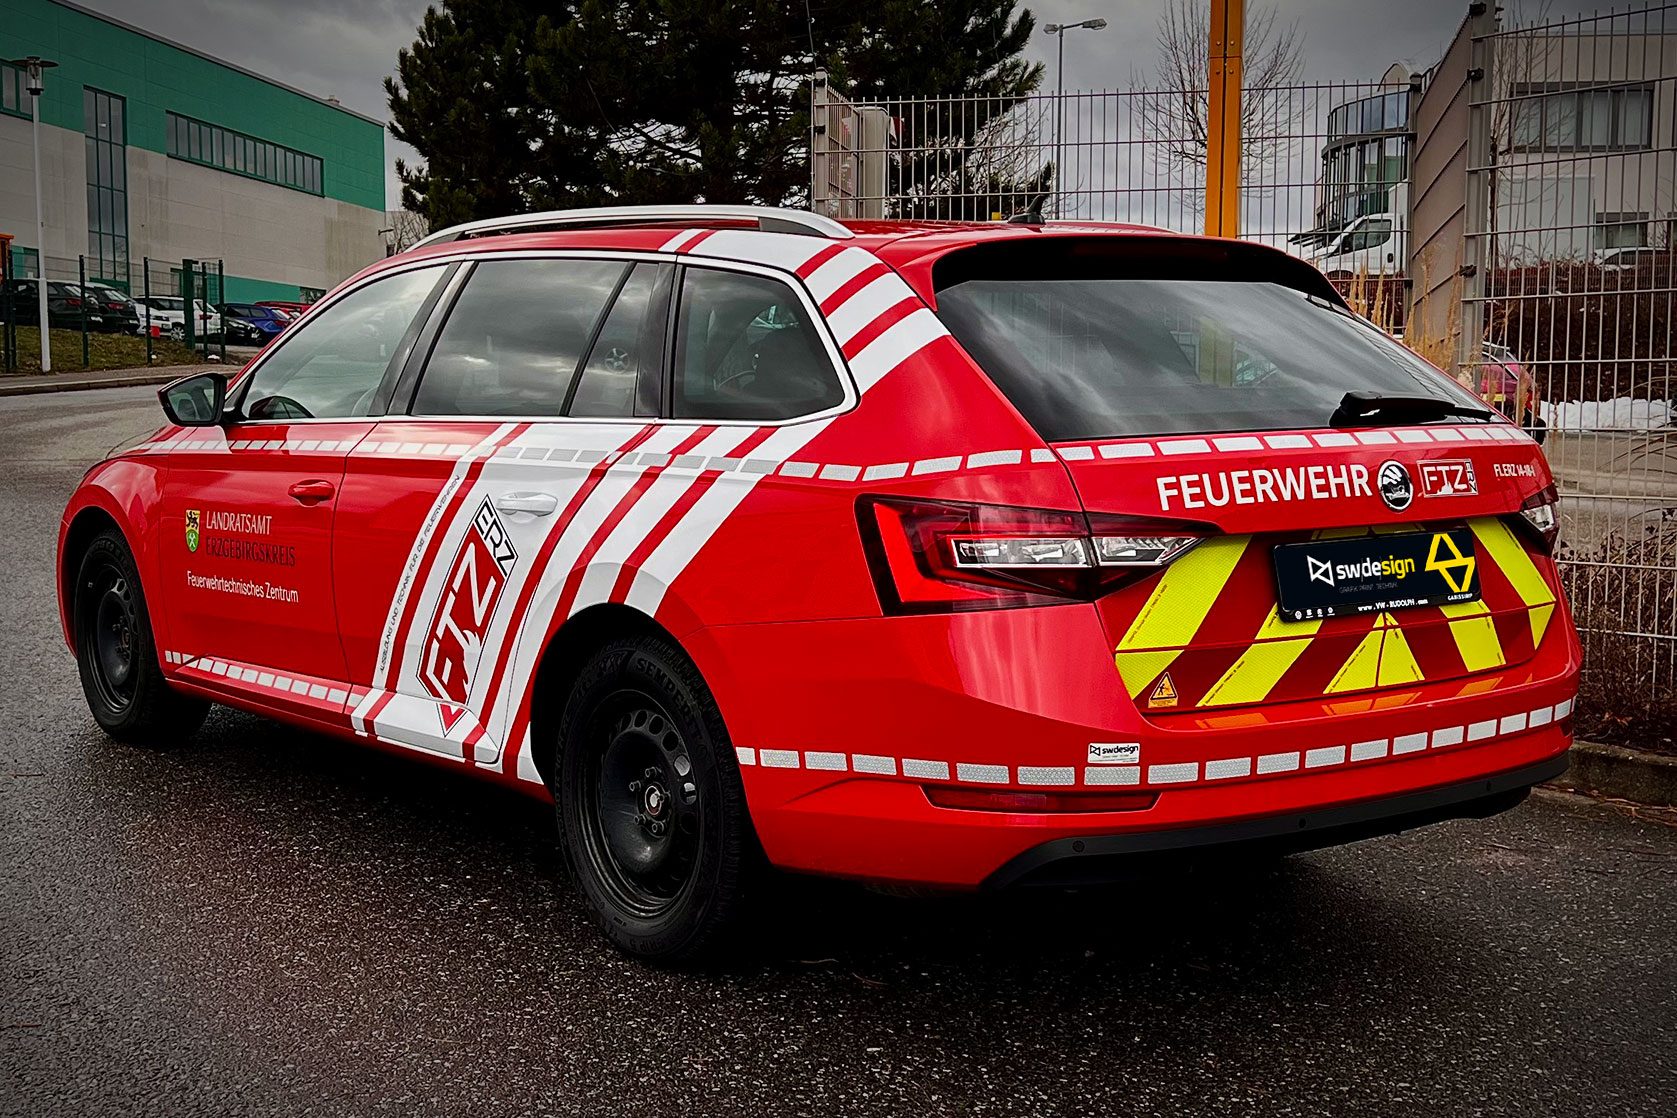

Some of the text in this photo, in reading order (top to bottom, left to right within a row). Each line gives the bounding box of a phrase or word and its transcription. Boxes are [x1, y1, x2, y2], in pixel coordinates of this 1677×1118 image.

[1156, 463, 1373, 511] FEUERWEHR
[1422, 464, 1468, 492] FTZ
[206, 510, 273, 535] LANDRATSAMT
[206, 537, 296, 567] ERZGEBIRGSKREIS
[475, 501, 515, 577] ERZ
[1336, 555, 1416, 579] swdesign
[187, 570, 300, 603] Feuerwehrtechnisches Zentrum
[390, 607, 399, 626] UND
[426, 542, 497, 713] FTZ
[1102, 744, 1139, 755] swdesign
